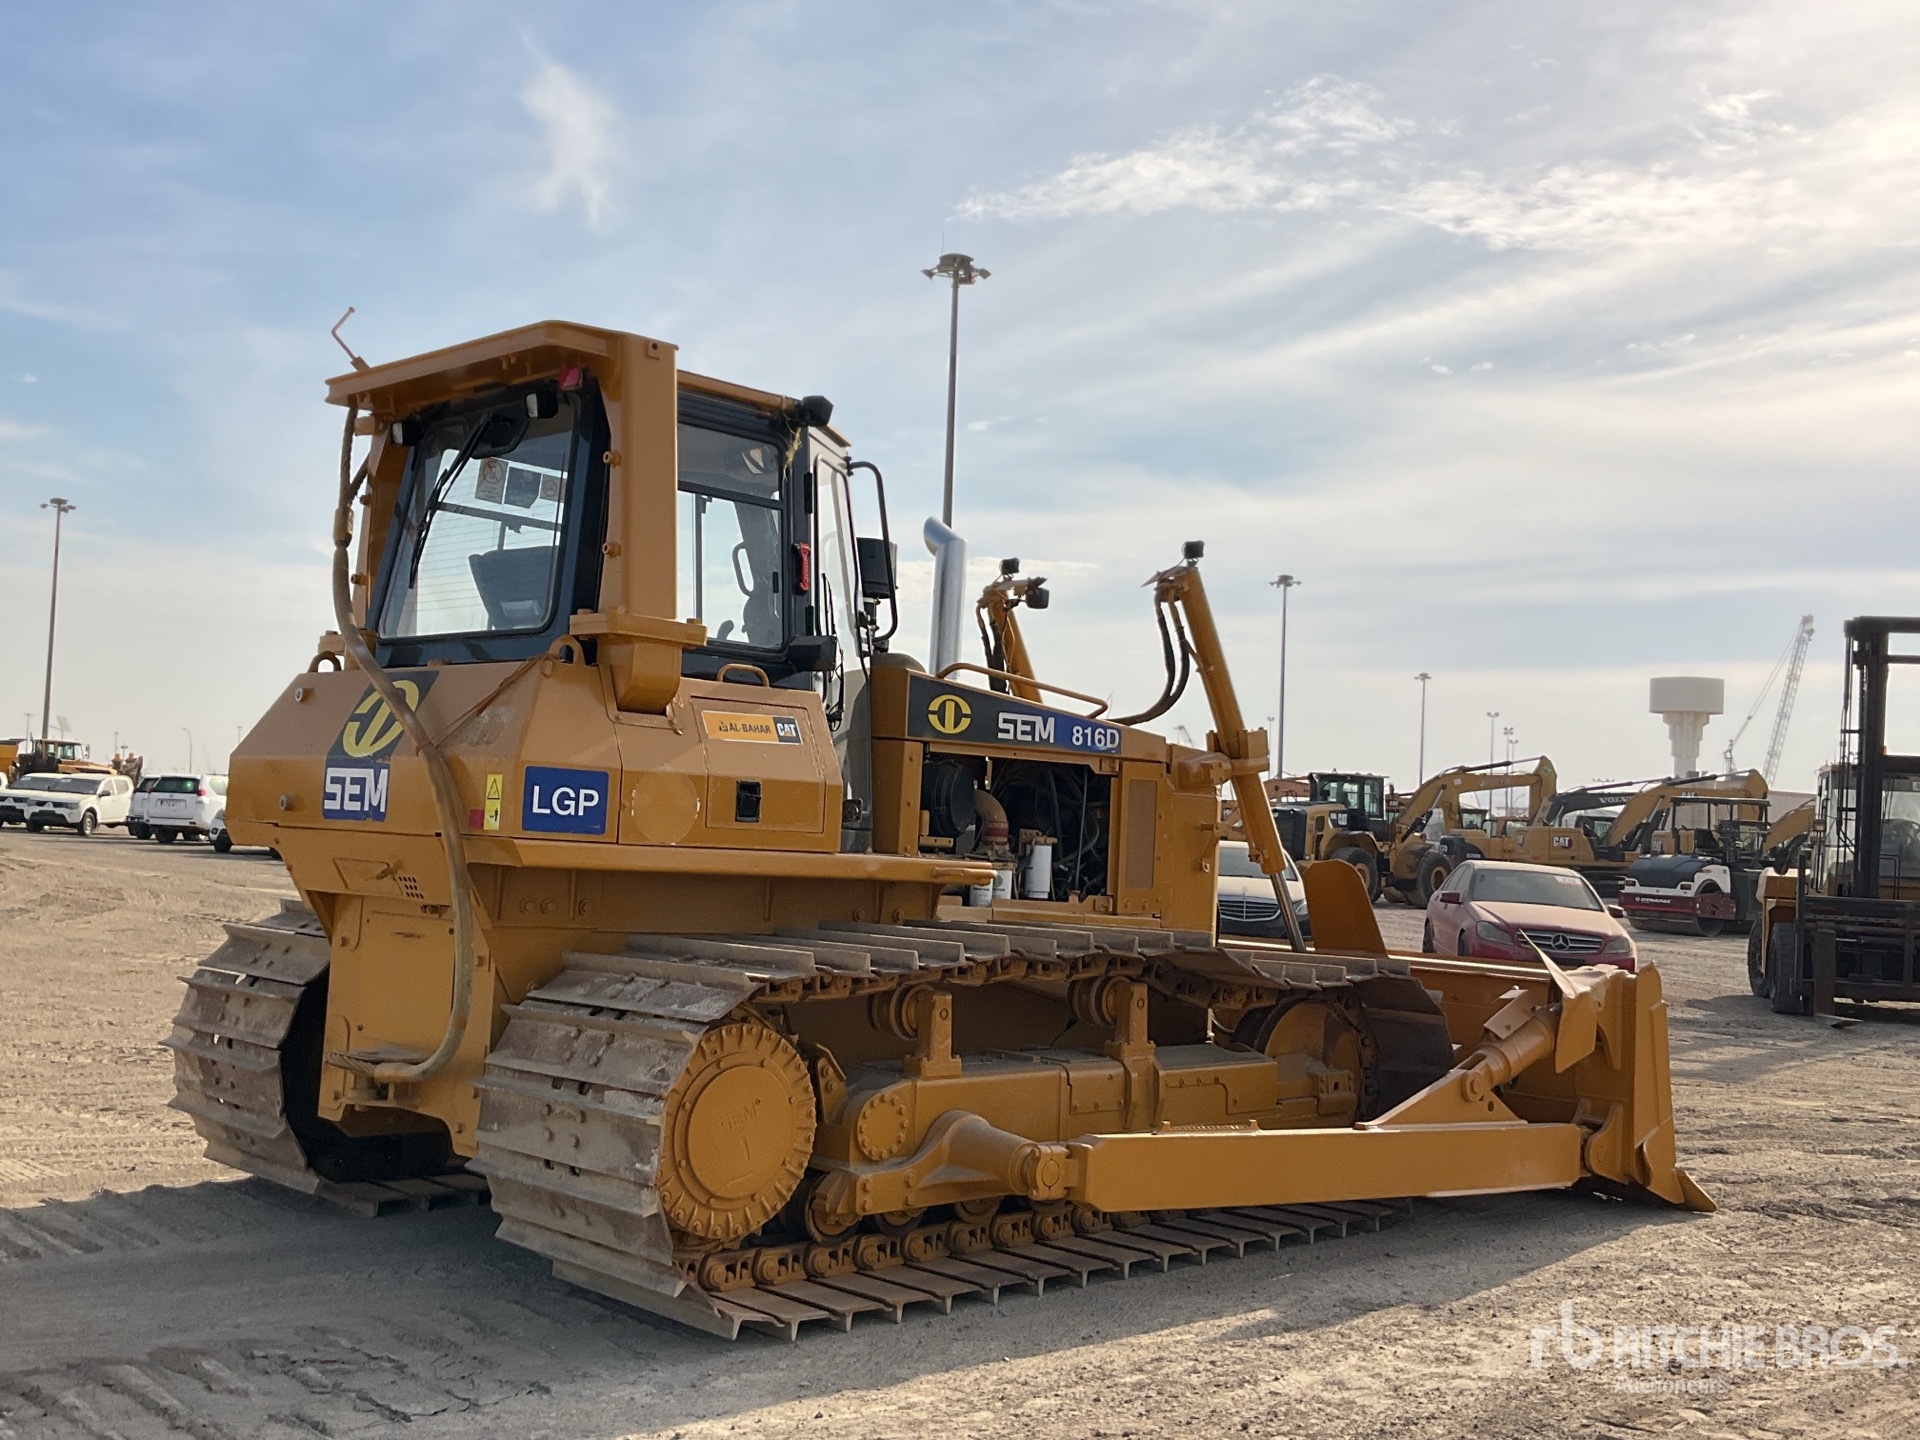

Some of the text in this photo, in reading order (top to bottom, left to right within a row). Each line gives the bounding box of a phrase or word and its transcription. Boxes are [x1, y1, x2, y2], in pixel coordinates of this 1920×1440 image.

[729, 722, 772, 734] AL-BAHAR
[776, 723, 796, 737] CAT
[997, 711, 1120, 749] SEM 816D
[323, 767, 389, 813] SEM
[531, 785, 600, 816] LGP
[1599, 795, 1633, 804] VOLV
[1553, 836, 1570, 847] CAT
